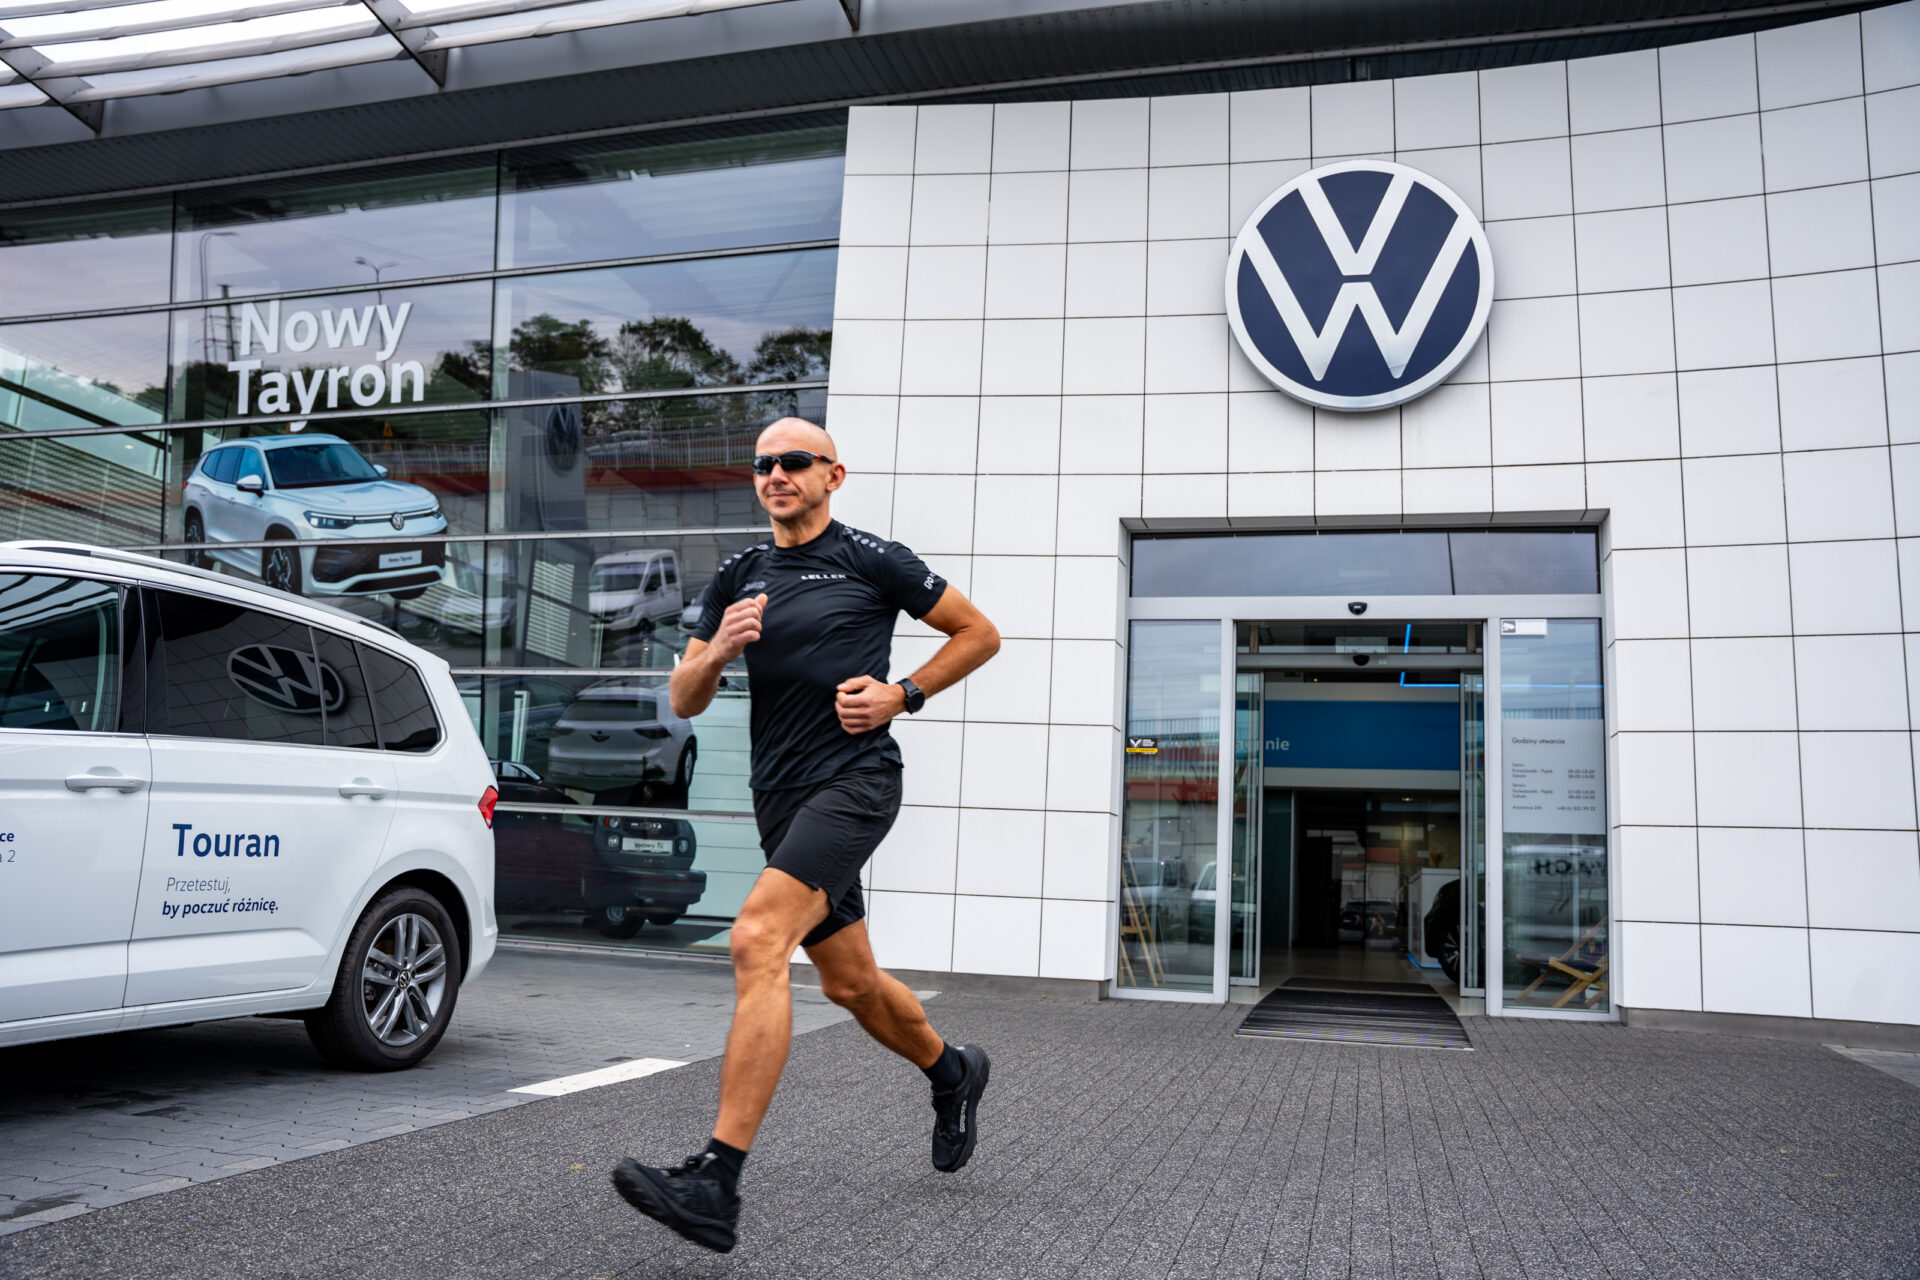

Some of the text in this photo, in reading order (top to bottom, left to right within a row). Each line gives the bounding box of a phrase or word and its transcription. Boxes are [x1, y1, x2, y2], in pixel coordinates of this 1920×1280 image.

[239, 299, 413, 362] Nowy
[227, 359, 425, 432] Tayron
[172, 823, 280, 857] Touran
[7, 849, 16, 863] 2
[166, 876, 231, 895] Przetestuj,
[162, 897, 279, 919] by poczuć różnicę.
